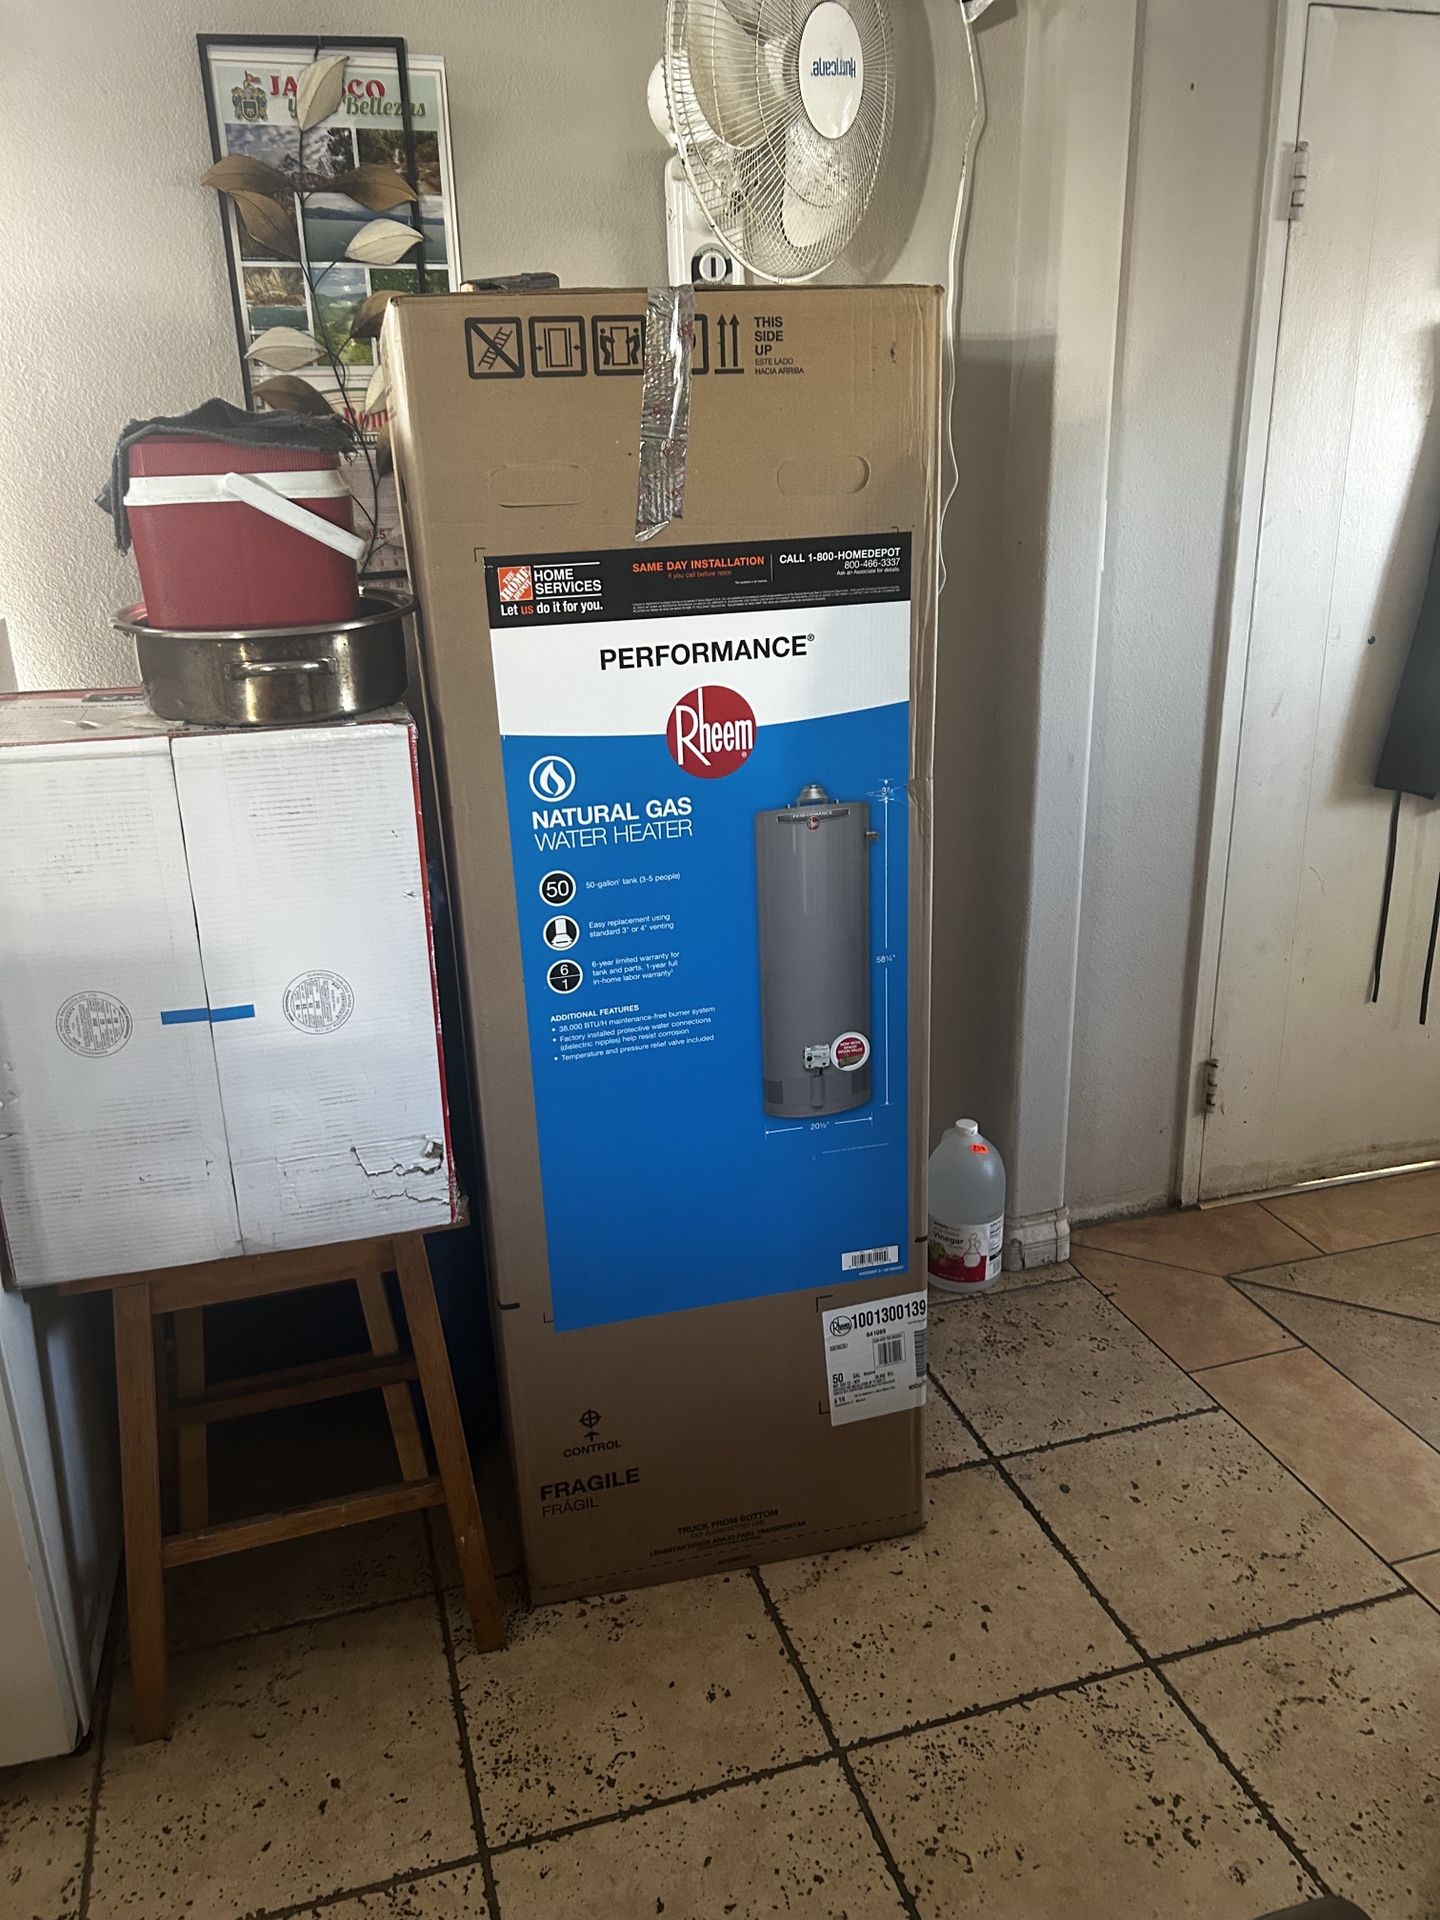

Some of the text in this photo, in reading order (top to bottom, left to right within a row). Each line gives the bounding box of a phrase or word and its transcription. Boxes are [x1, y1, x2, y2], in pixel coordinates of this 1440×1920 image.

[270, 74, 386, 98] JACO
[754, 316, 783, 328] THIS
[754, 330, 783, 342] SIDE
[755, 344, 773, 356] UP
[755, 357, 794, 366] ESTE LADO
[778, 367, 804, 375] ARRIBA
[779, 547, 901, 564] CALL 1-800-HOMEDEPOT
[632, 556, 765, 573] SAME DAY INSTALLATION
[844, 558, 901, 570] 800-466-3337
[502, 570, 515, 585] THE
[534, 568, 574, 582] HOME
[500, 566, 530, 600] HOME
[513, 579, 531, 600] DEPOT
[536, 580, 602, 595] SERVICES
[501, 601, 603, 616] Let us do it for you.
[532, 796, 692, 830] NATURAL GAS
[534, 819, 693, 852] WATER HEATER
[622, 877, 637, 885] tank
[640, 875, 653, 884] (3-5
[655, 872, 680, 883] people)
[546, 880, 569, 898] 50
[589, 914, 670, 929] Easy replacement using
[589, 928, 620, 938] standard
[649, 922, 674, 930] venting
[592, 960, 613, 968] 6-year
[615, 956, 638, 965] limited
[640, 953, 669, 962] warranty
[560, 964, 568, 975] 6
[592, 968, 608, 976] tank
[609, 966, 622, 974] and
[646, 962, 666, 970] 1-year
[561, 979, 568, 990] 1
[593, 976, 621, 985] in-home
[623, 973, 640, 981] labor
[551, 1004, 639, 1023] ADDITIONAL FEATURES
[609, 1012, 667, 1026] maintenance-free
[668, 1009, 690, 1018] burner
[692, 1006, 715, 1016] system
[560, 1017, 712, 1043] Factory installed protective water connections
[560, 1028, 689, 1052] (dielectric nipples) help resist corrosion
[561, 1034, 714, 1061] Temperature and pressure relief valve included
[933, 1230, 964, 1245] Vinegar
[832, 1300, 926, 1334] Rheem 1001300139
[832, 1373, 843, 1384] 50
[563, 1440, 622, 1458] CONTROL
[540, 1468, 640, 1500] FRAGILE
[677, 1509, 779, 1535] TRUCK FROM BOTTOM
